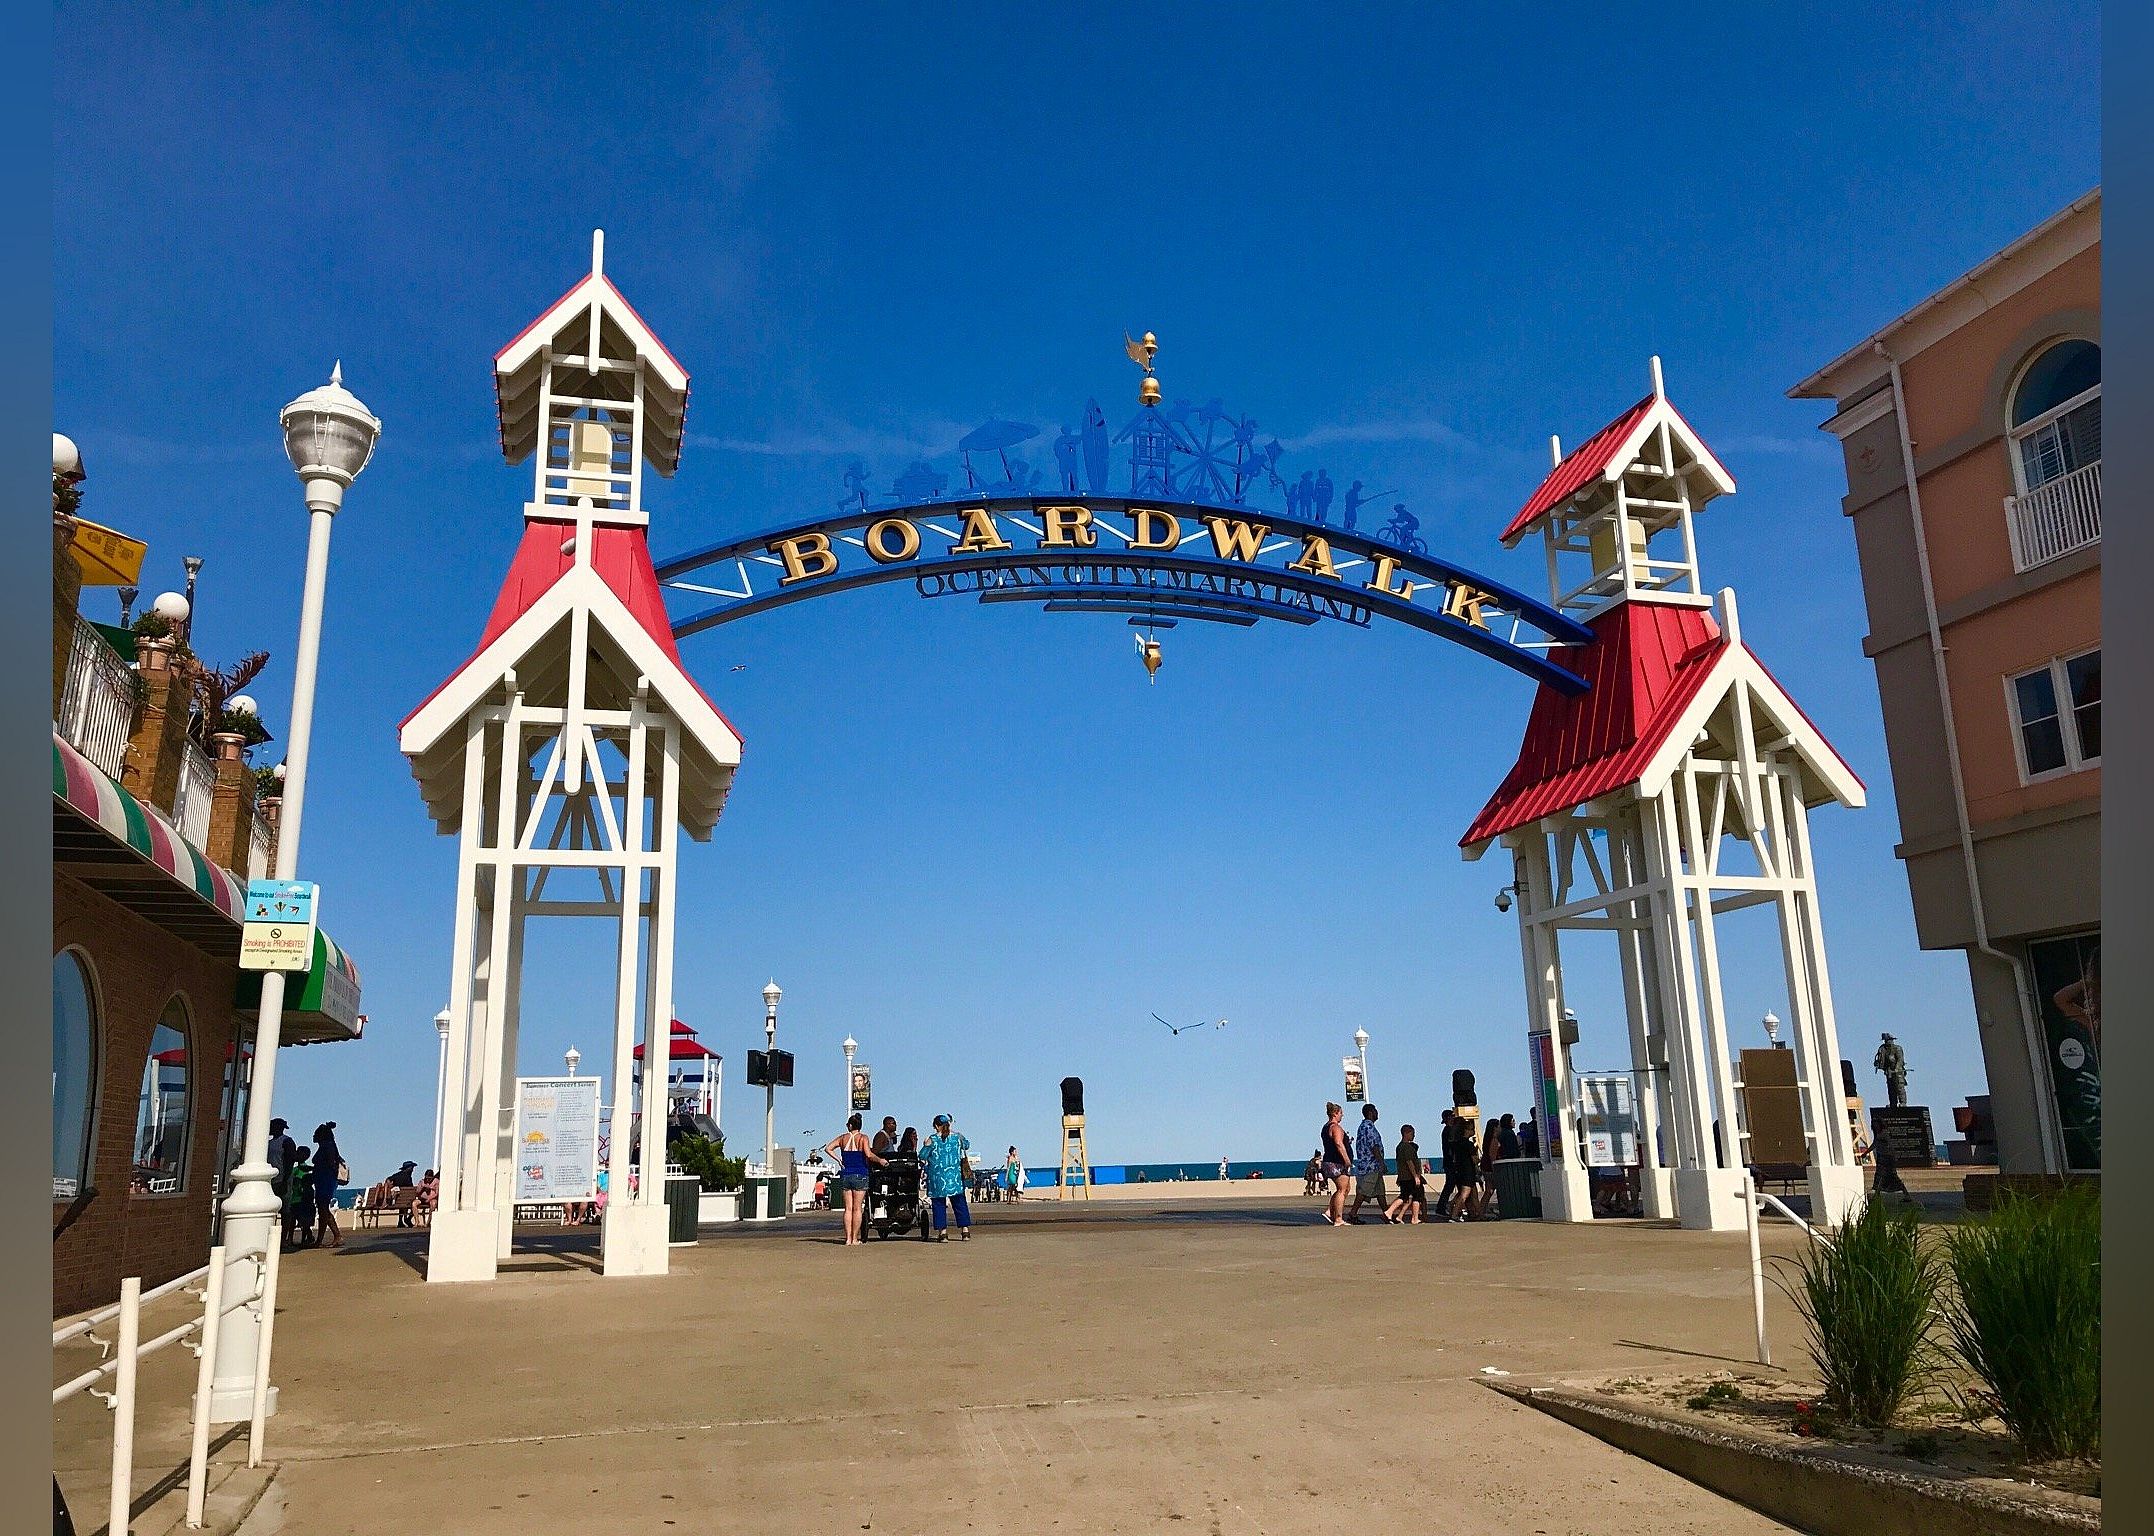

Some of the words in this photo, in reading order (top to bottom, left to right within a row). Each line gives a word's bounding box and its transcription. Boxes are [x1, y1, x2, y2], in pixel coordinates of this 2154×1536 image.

[767, 505, 1499, 633] BOARDWALK
[916, 565, 1052, 598] OCEAN
[1166, 567, 1372, 626] MARYLAND
[244, 939, 266, 948] Smoking
[273, 939, 305, 948] PROHIBITED
